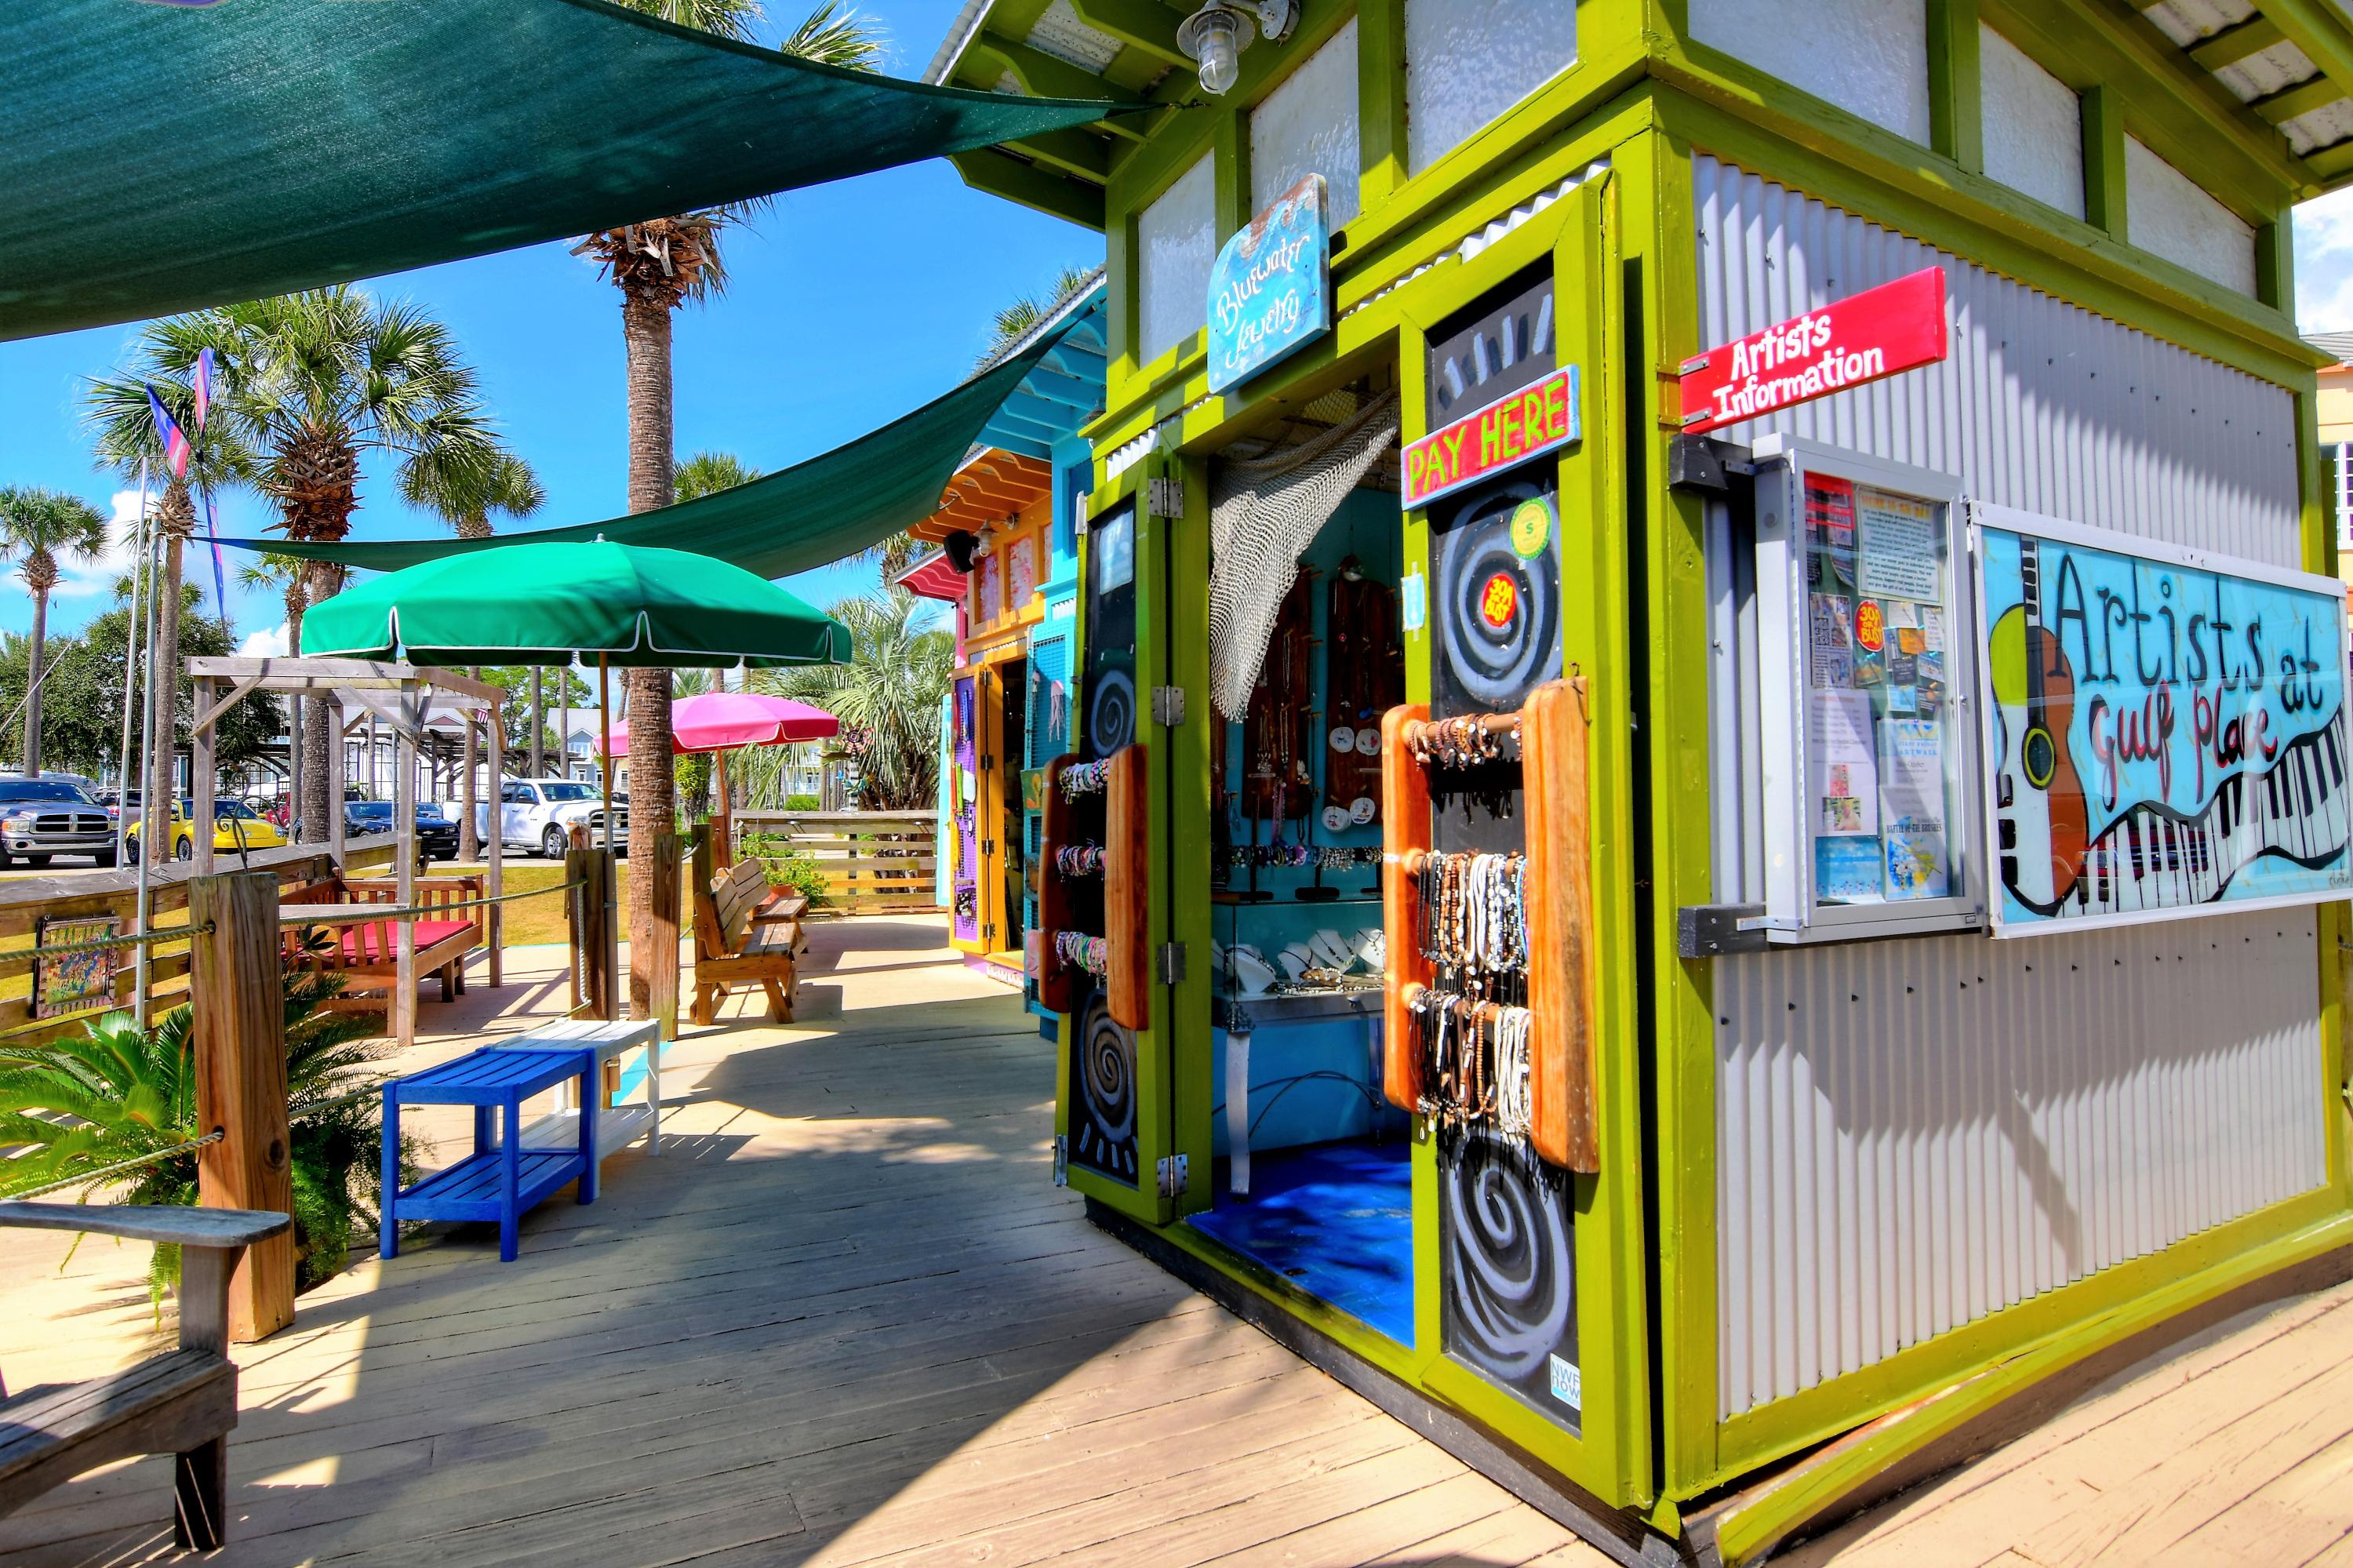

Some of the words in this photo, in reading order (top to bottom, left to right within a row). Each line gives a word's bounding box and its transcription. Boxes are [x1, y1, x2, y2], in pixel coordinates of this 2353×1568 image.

[1217, 235, 1310, 336] Bluewater
[1225, 289, 1300, 369] Jewelry
[1730, 315, 1832, 381] Artists
[1712, 347, 1884, 422] Information
[1408, 427, 1465, 500] PAY
[1481, 377, 1566, 463] HERE
[1484, 598, 1510, 622] BUST
[1489, 578, 1513, 607] 30A
[1859, 606, 1881, 626] 30A
[2047, 552, 2265, 691] Artists
[2279, 616, 2324, 713] at
